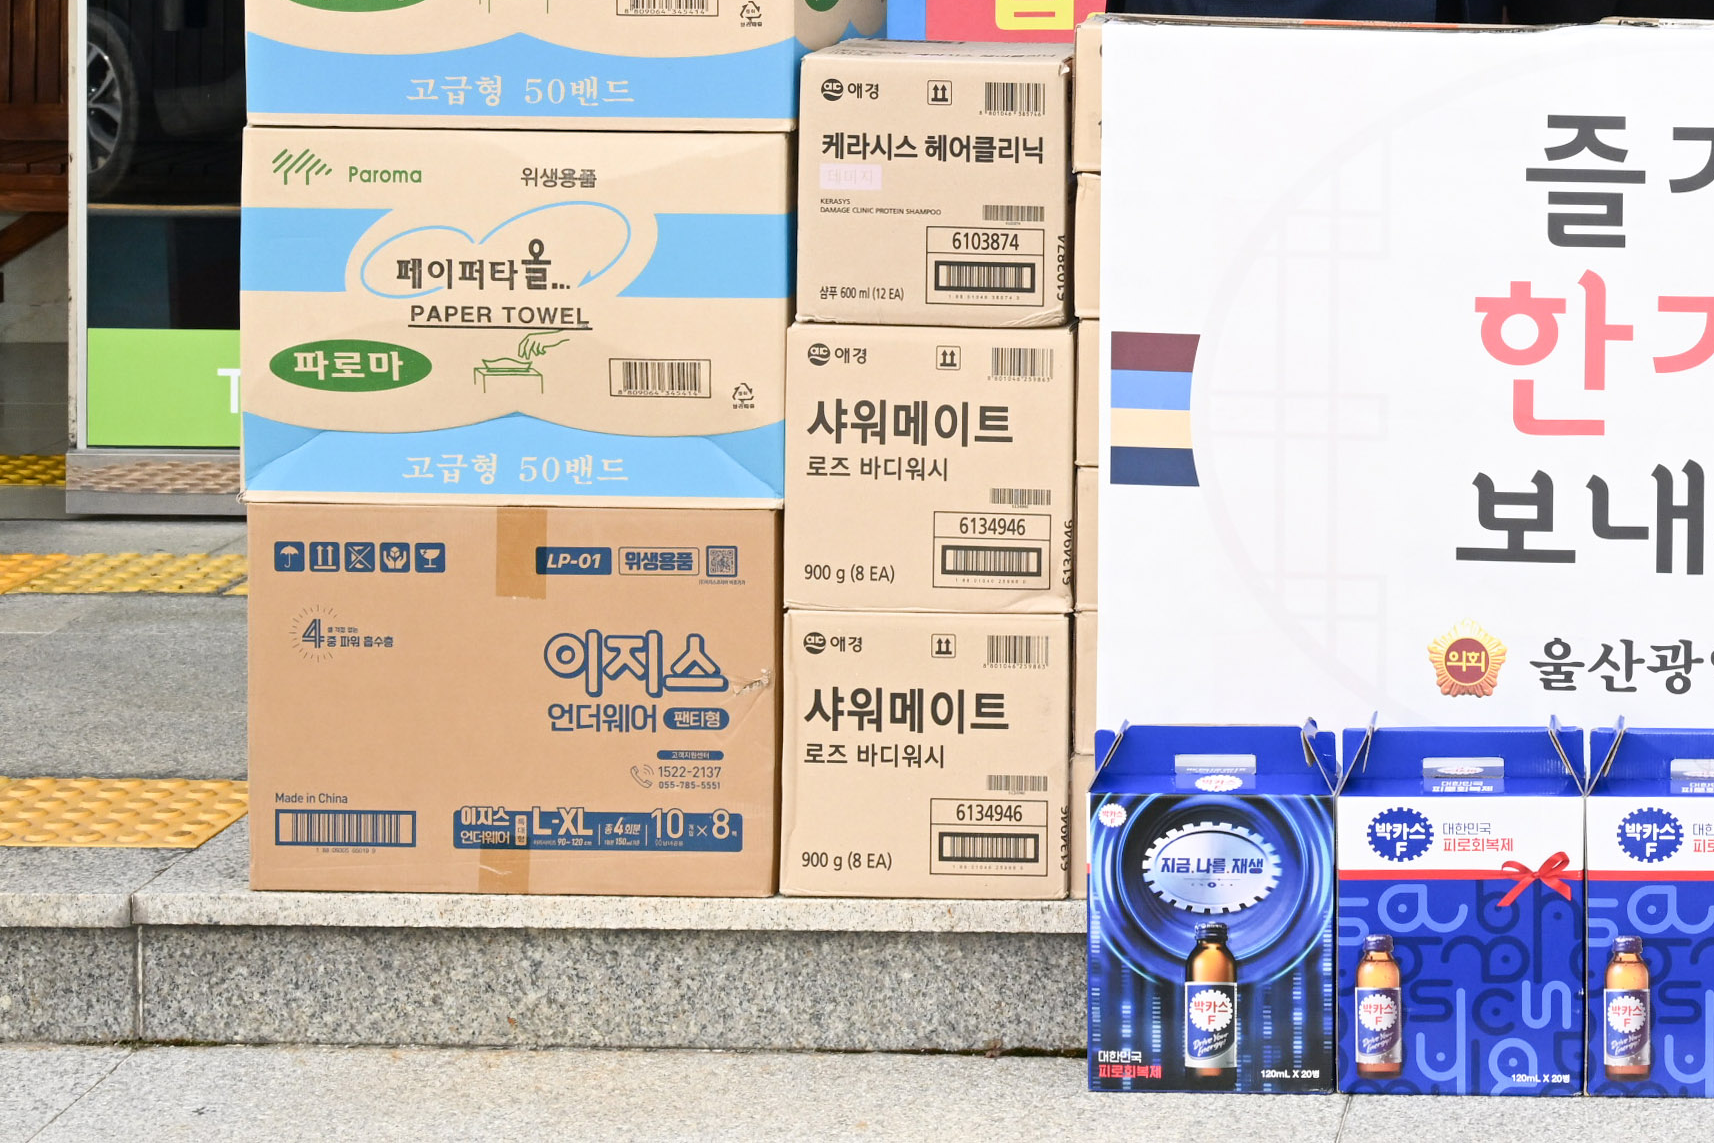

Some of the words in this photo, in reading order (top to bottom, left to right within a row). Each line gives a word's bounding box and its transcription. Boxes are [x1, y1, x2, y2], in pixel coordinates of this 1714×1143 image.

[406, 74, 504, 106] 고급형
[523, 75, 637, 106] 50밴드
[847, 82, 880, 100] 애경
[821, 132, 919, 160] 케라시스
[924, 134, 1044, 164] 헤어클리닉
[348, 165, 422, 184] Paroma
[520, 168, 598, 189] 위생용품
[820, 206, 850, 214] DAMAGE
[875, 207, 905, 215] PROTEIN
[905, 208, 942, 216] SHAMPOO
[952, 231, 1020, 251] 6103874
[819, 286, 838, 300] 샴푸
[840, 287, 857, 299] 600
[858, 287, 871, 299] ml
[872, 288, 886, 300] (12
[888, 288, 905, 301] EA)
[409, 304, 492, 324] PAPER
[502, 305, 590, 326] TOWEL
[834, 347, 867, 364] 애경
[294, 350, 403, 382] 파로마
[807, 398, 1013, 447] 샤워메이트
[401, 453, 499, 484] 고급형
[518, 455, 628, 485] 50밴드
[806, 455, 851, 477] 로즈
[860, 456, 949, 481] 바디워시
[959, 516, 1026, 536] 6134946
[547, 553, 601, 569] LP-01
[624, 551, 694, 571] 위생용품
[804, 564, 831, 580] 900
[836, 568, 846, 583] g
[850, 564, 865, 583] (8
[869, 565, 895, 583] EA)
[340, 636, 360, 648] 파워
[830, 635, 863, 653] 애경
[543, 628, 730, 699] 이지스
[1446, 647, 1487, 669] 의회
[547, 703, 657, 733] 언더웨어
[673, 710, 721, 729] 팬티형
[803, 686, 1009, 734] 샤워메이트
[671, 751, 710, 760] 고객지원센터
[803, 742, 848, 765] 로즈
[857, 743, 945, 768] 바디워시
[658, 766, 721, 779] 1522-2137
[658, 781, 721, 790] 055-785-5551
[275, 792, 304, 804] Made
[318, 792, 348, 804] China
[460, 806, 510, 826] 이지스
[532, 807, 593, 836] L-XL
[956, 804, 1023, 822] 6134946
[651, 808, 684, 839] 10
[712, 808, 731, 840] 8
[1375, 822, 1426, 841] 박카스
[1443, 822, 1491, 836] 대한민국
[1625, 823, 1676, 841] 박카스
[460, 830, 510, 845] 언더웨어
[1443, 837, 1514, 852] 피로회복제
[1396, 842, 1408, 856] F
[1645, 843, 1657, 857] F
[802, 851, 829, 867] 900
[833, 855, 843, 870] g
[848, 852, 862, 870] (8
[867, 852, 892, 871] EA)
[1161, 857, 1264, 874] 지금.나를.재생
[1194, 1001, 1228, 1013] 박카스
[1363, 1004, 1394, 1015] 박카스
[1611, 1005, 1643, 1017] 박카스
[1098, 1050, 1142, 1064] 대한민국
[1098, 1065, 1163, 1079] 피로회복제
[1261, 1070, 1290, 1078] 120mL
[1301, 1069, 1320, 1079] 20병
[1511, 1074, 1541, 1083] 120mL
[1552, 1074, 1570, 1084] 20병
